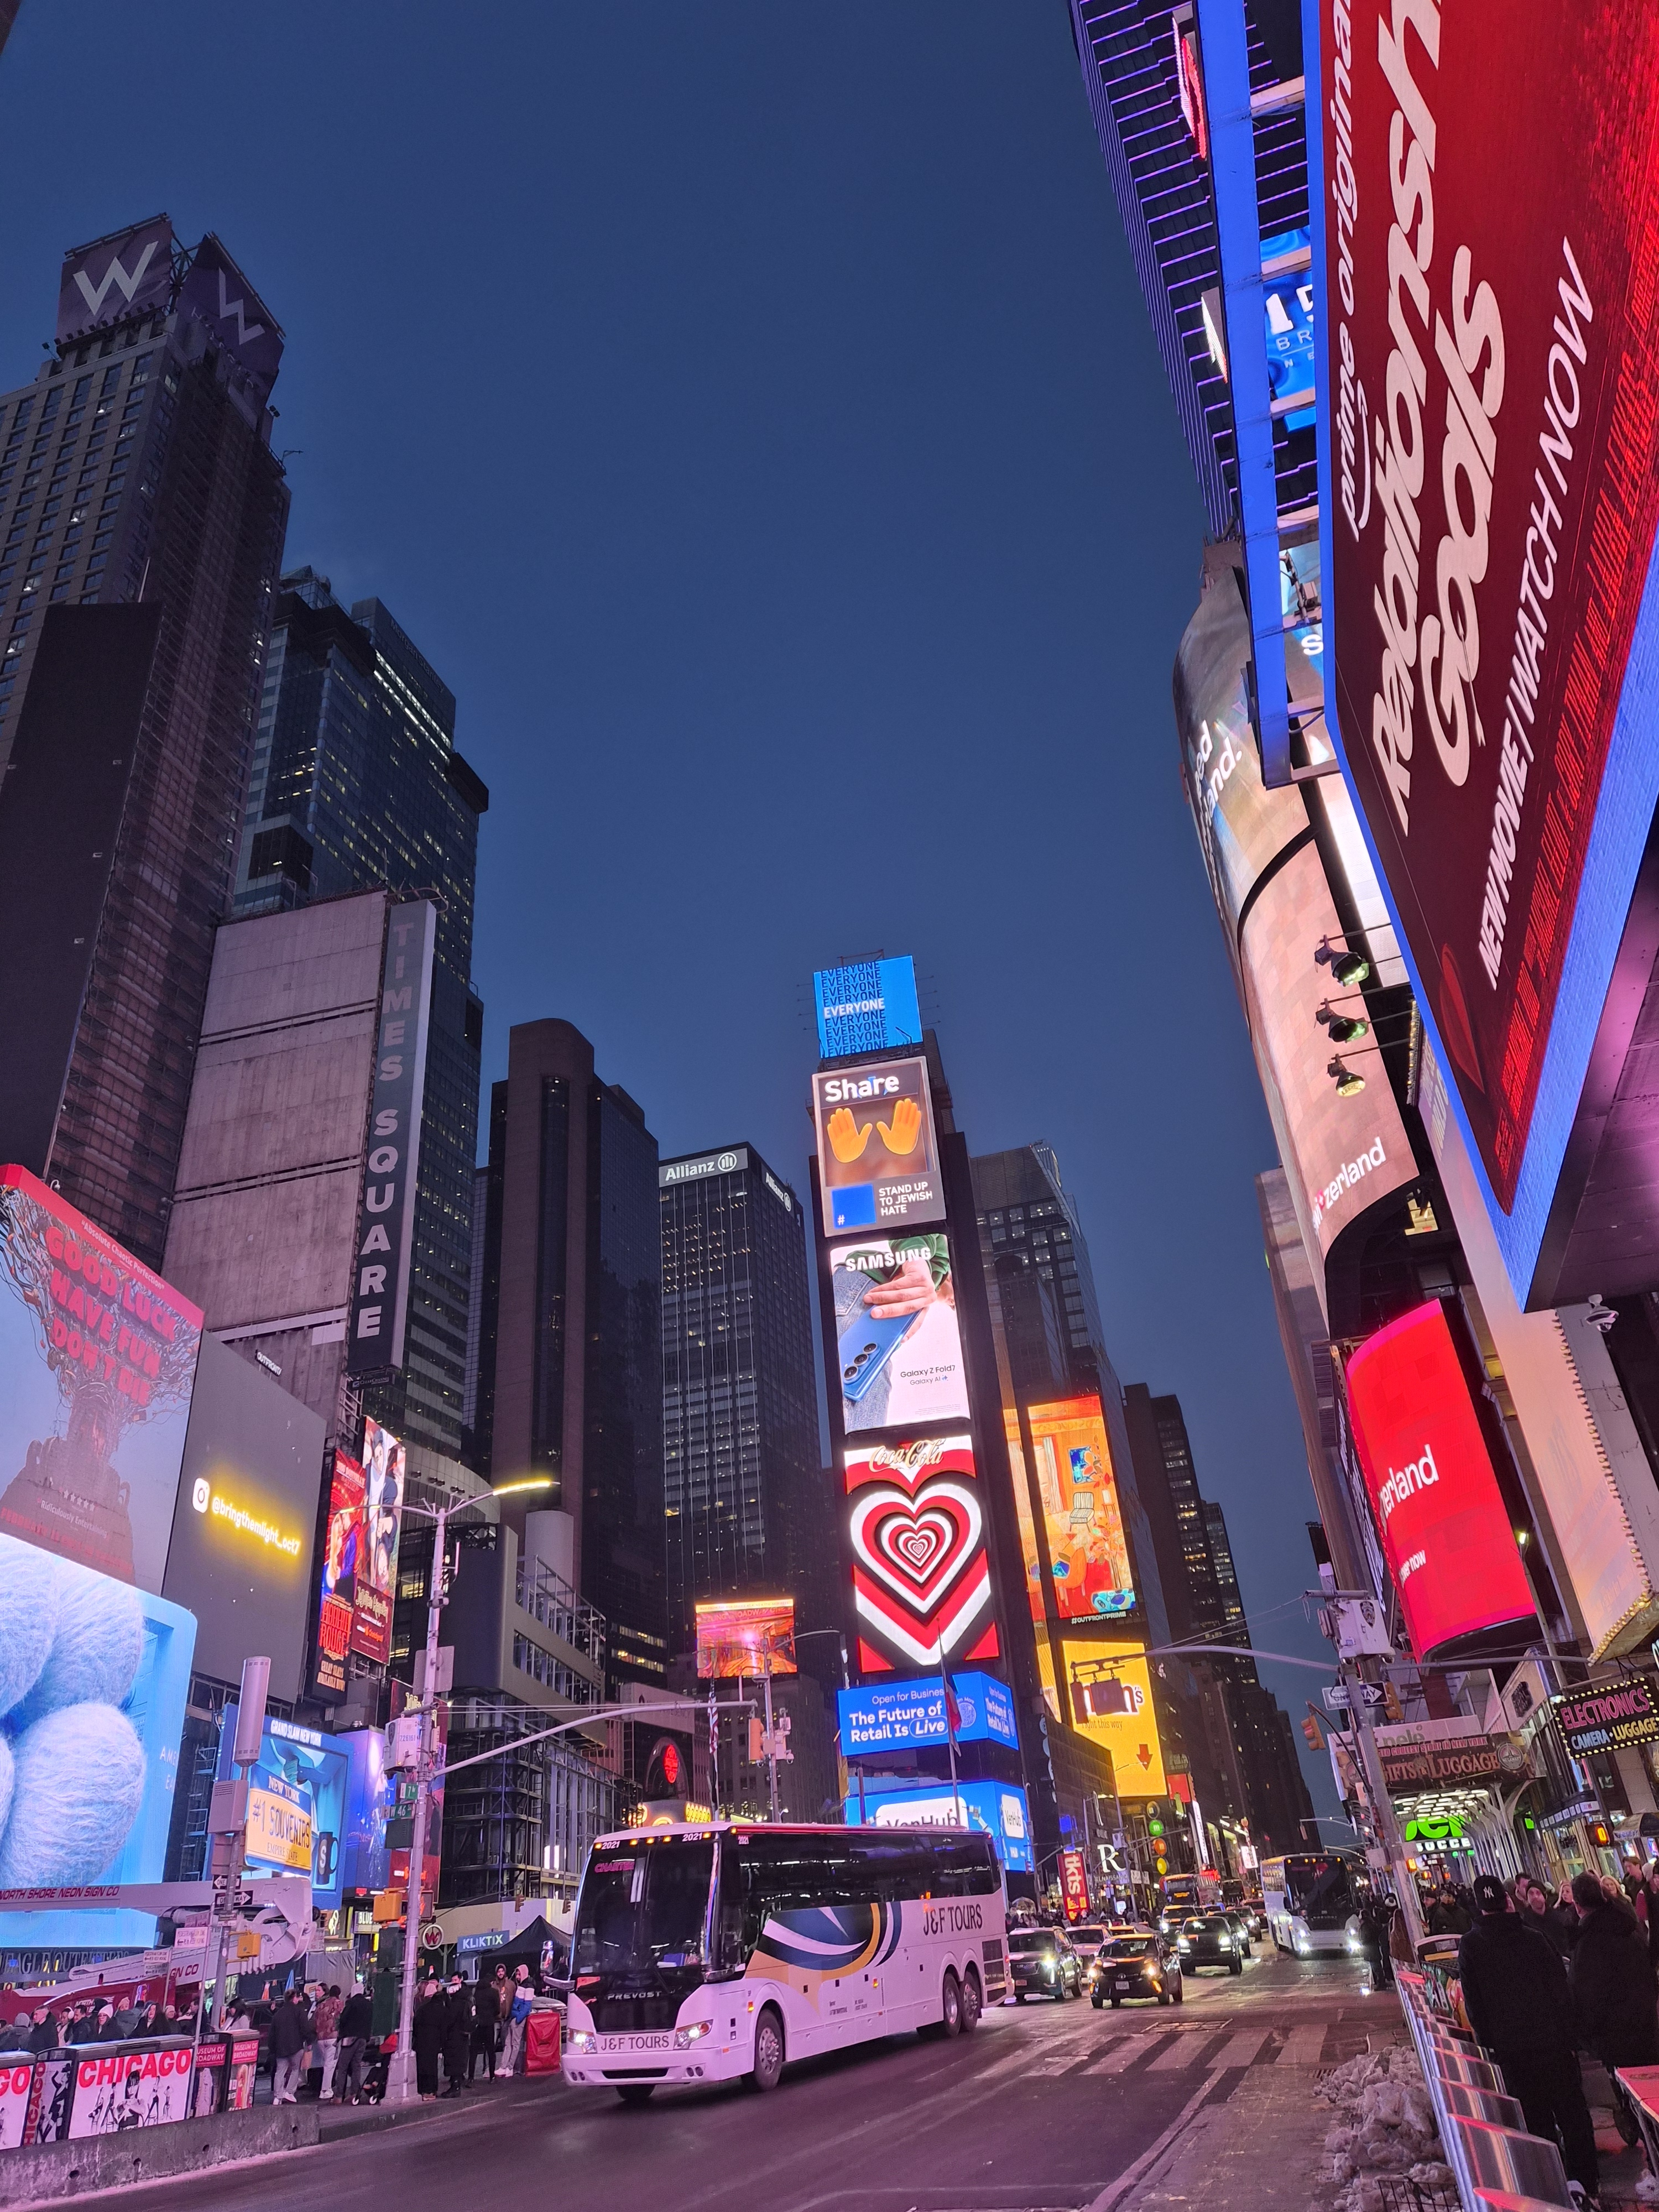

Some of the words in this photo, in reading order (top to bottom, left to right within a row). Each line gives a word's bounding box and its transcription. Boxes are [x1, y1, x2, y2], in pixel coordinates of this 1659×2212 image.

[1330, 0, 1357, 316] origina
[73, 241, 159, 316] W
[1540, 236, 1594, 496] NOW
[1373, 0, 1442, 837] Relationsh
[1337, 322, 1359, 542] prime
[1422, 245, 1505, 787] Goals
[1510, 468, 1563, 723] WATCH
[1489, 734, 1528, 904] MOVIE
[1479, 867, 1507, 990] NEW
[821, 969, 881, 988] EVERYONE
[822, 979, 883, 998] EVERYONE
[379, 922, 415, 1082] TIMES
[823, 988, 883, 1008] EVERYONE
[824, 998, 885, 1018] EVERYONE
[825, 1009, 886, 1028] EVERYONE
[826, 1019, 887, 1039] EVERYONE
[827, 1029, 888, 1048] EVERYONE
[825, 1075, 900, 1103] Share
[665, 1160, 715, 1181] Allianz
[765, 1172, 784, 1202] Allianz
[879, 1186, 911, 1197] STAND
[914, 1181, 928, 1192] UP
[880, 1196, 893, 1206] TO
[895, 1191, 933, 1204] JEWISH
[880, 1204, 908, 1217] HATE
[356, 1109, 399, 1339] SQUARE
[112, 1244, 133, 1267] Chaotic
[846, 1246, 932, 1272] SAMSUNG
[45, 1226, 118, 1296] GOOD
[123, 1284, 177, 1343] LUCK
[50, 1268, 114, 1342] HAVE
[118, 1326, 161, 1378] FUN
[900, 1369, 928, 1380] Galaxy
[936, 1364, 956, 1373] Fold7
[910, 1378, 933, 1386] Galaxy
[118, 1368, 150, 1406] DIE
[212, 1495, 301, 1557] @bringthemlight_oct7
[1411, 1550, 1427, 1571] now
[1071, 1611, 1126, 1625] #OUTFRONTPRIME
[872, 1694, 896, 1705] Open
[896, 1692, 910, 1702] for
[911, 1688, 945, 1700] Busines
[849, 1712, 875, 1726] The
[878, 1708, 925, 1723] Future
[928, 1701, 943, 1716] of
[1560, 1687, 1650, 1730] ELECTRONICS
[271, 1719, 288, 1739] GRAND
[288, 1724, 301, 1741] SLAM
[300, 1728, 311, 1743] NEW
[310, 1731, 322, 1747] YORK
[851, 1727, 893, 1742] Retail
[894, 1724, 909, 1736] Is
[915, 1719, 946, 1735] Live
[1098, 1718, 1110, 1729] this
[1110, 1720, 1123, 1731] way
[1571, 1728, 1611, 1751] CAMERA
[1612, 1717, 1658, 1741] LUGGAGE
[1391, 1745, 1419, 1756] COOLEST
[1442, 1741, 1452, 1751] IN
[1452, 1740, 1467, 1750] NEW
[1469, 1737, 1488, 1747] YORK
[1428, 1751, 1501, 1779] LUGGAGE
[269, 1775, 283, 1792] NEW
[284, 1784, 300, 1804] YORK
[408, 1786, 411, 1797] 7
[390, 1805, 395, 1814] W
[397, 1805, 406, 1816] 46
[252, 1797, 266, 1833] #1
[269, 1805, 311, 1849] SOUVENIRS
[601, 1840, 620, 1850] 2021
[682, 1832, 703, 1842] 2021
[267, 1841, 285, 1857] EMPIRE
[320, 1844, 327, 1866] S
[1097, 1844, 1126, 1873] R
[1064, 1854, 1081, 1895] tkts
[27, 1888, 56, 1899] SHORE
[58, 1887, 84, 1898] NEON
[85, 1887, 105, 1897] SIGN
[106, 1886, 120, 1896] CO
[924, 1908, 946, 1936] J&F
[948, 1904, 983, 1933] TOURS
[462, 1934, 503, 1949] KLIKTIX
[4, 1951, 50, 1974] EAGLE
[185, 1963, 199, 1976] CO
[607, 1989, 662, 2001] PREVOST
[196, 2046, 215, 2056] USEUM
[216, 2045, 225, 2054] OF
[233, 2048, 258, 2058] BROADWAY
[601, 2036, 625, 2052] J&F
[628, 2034, 670, 2050] TOURS
[79, 2049, 192, 2089] CHICAGO
[24, 2062, 46, 2146] HICAGO
